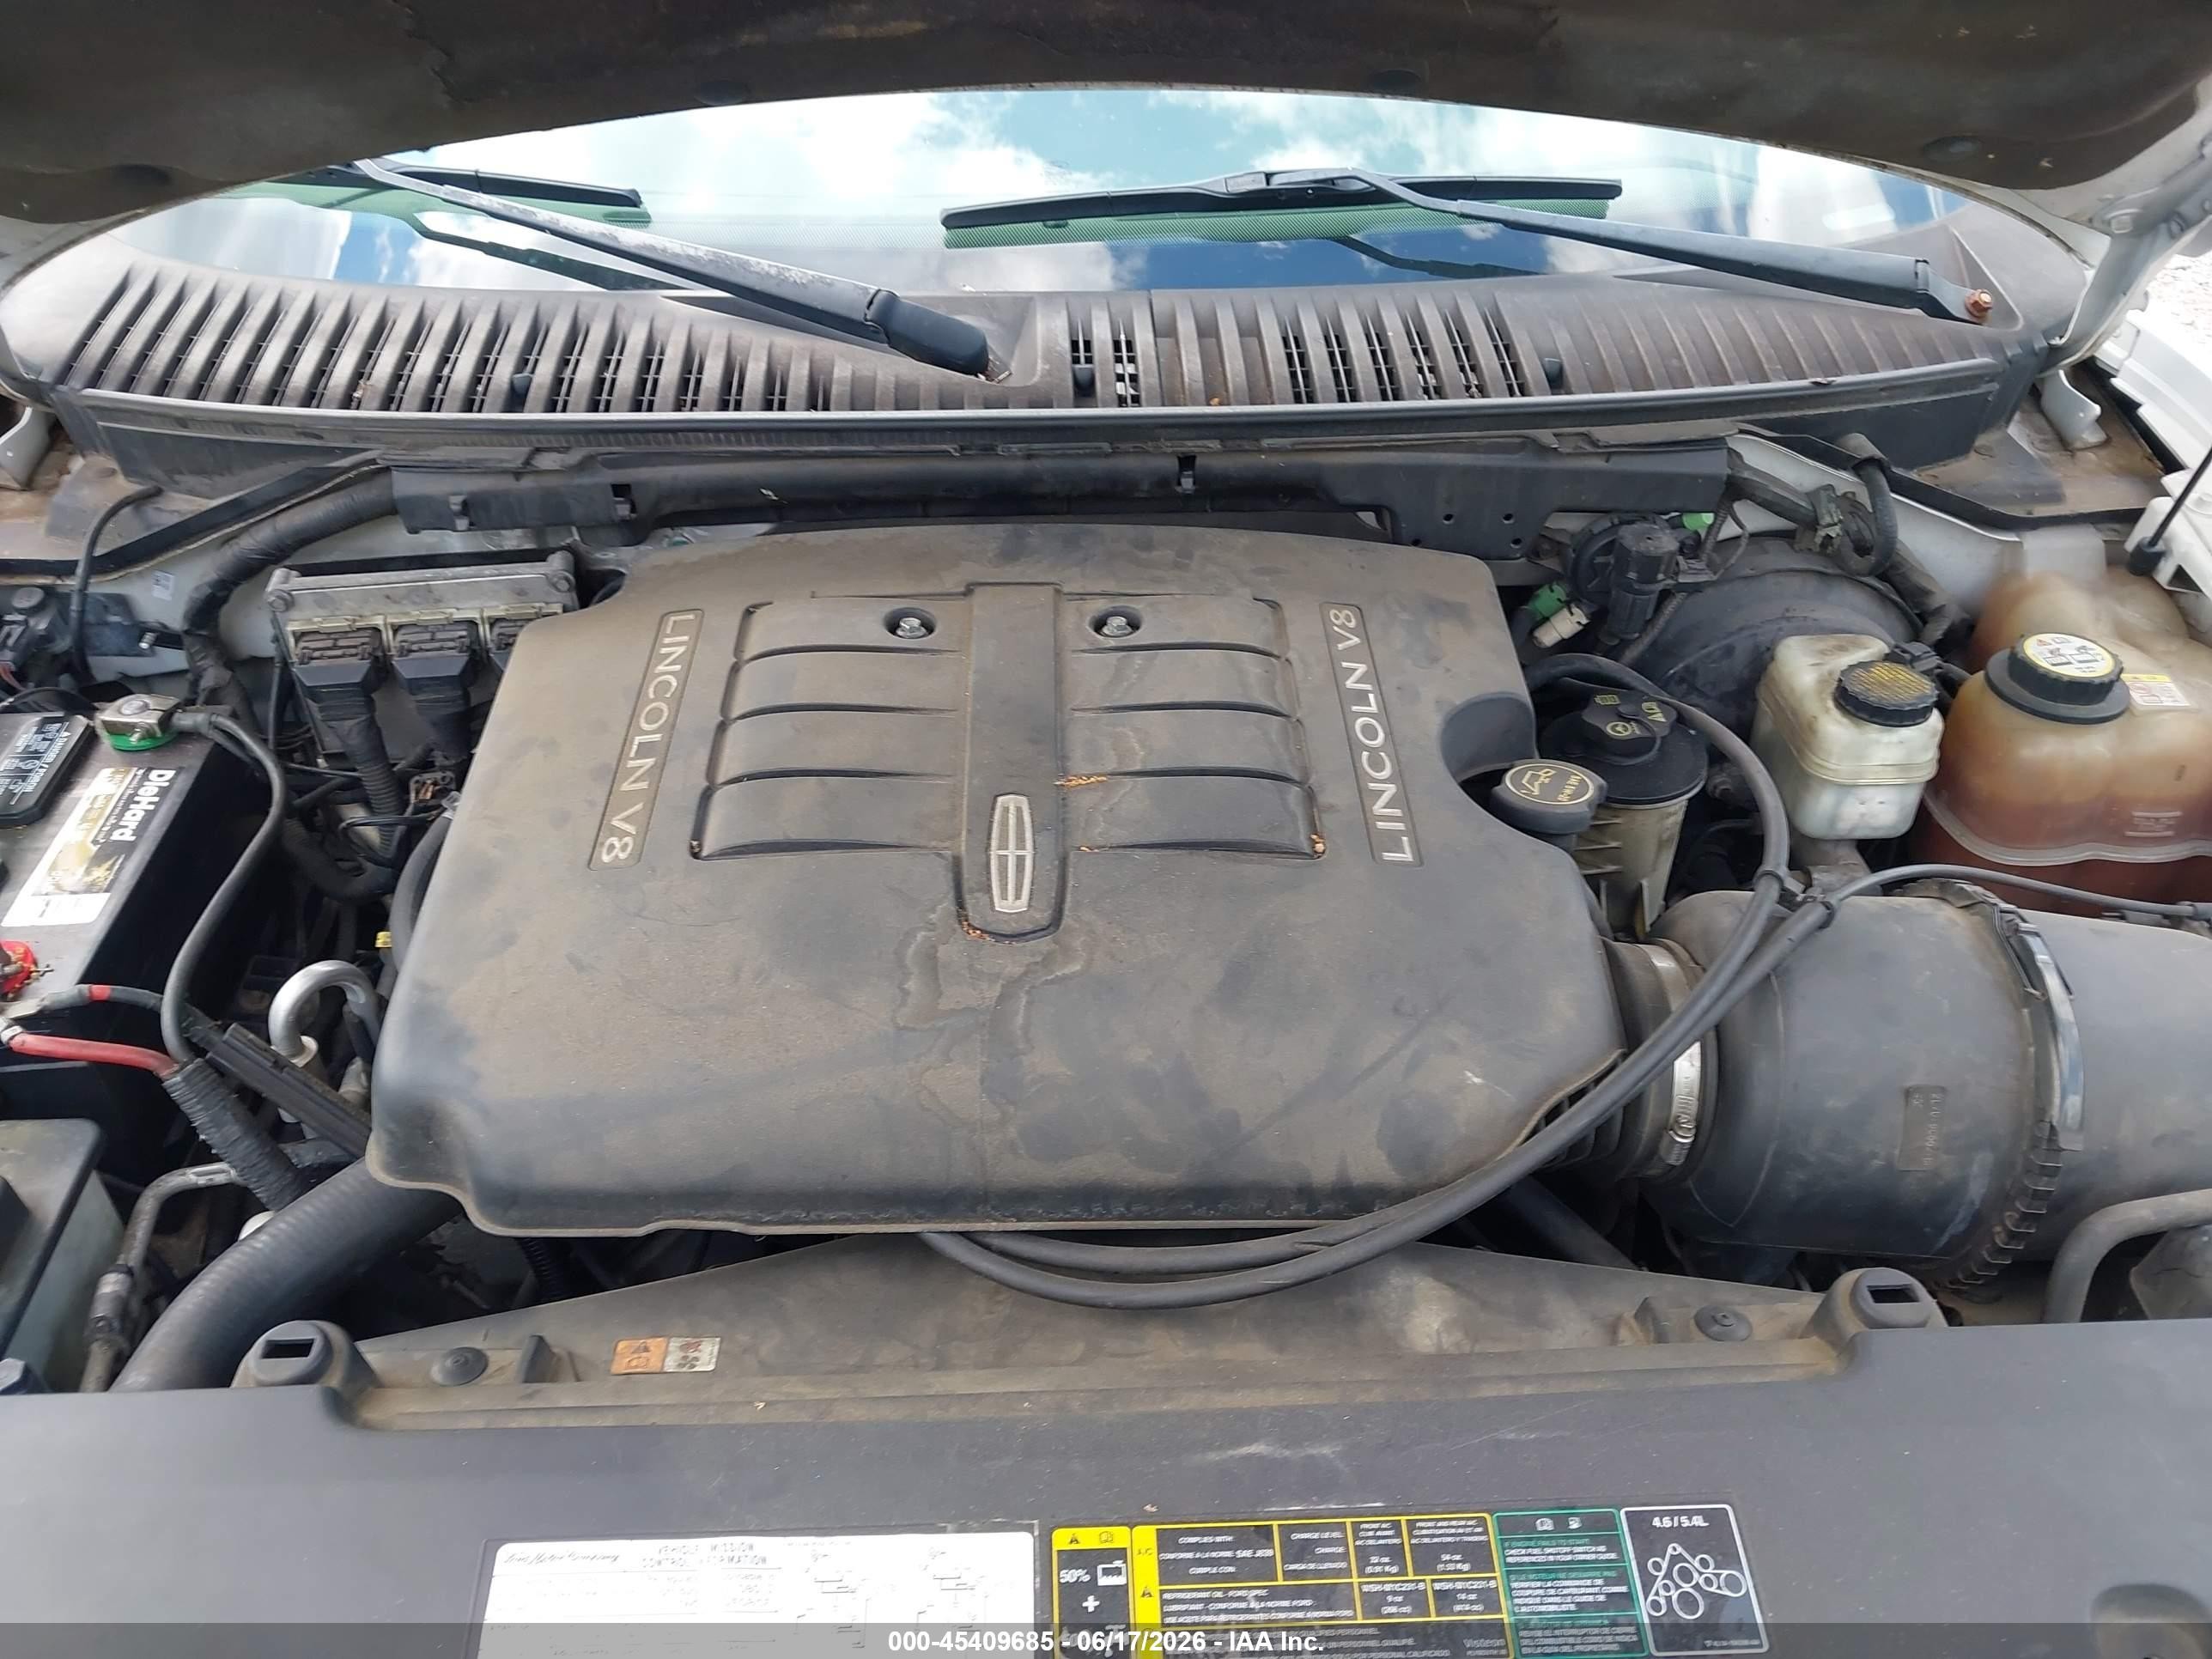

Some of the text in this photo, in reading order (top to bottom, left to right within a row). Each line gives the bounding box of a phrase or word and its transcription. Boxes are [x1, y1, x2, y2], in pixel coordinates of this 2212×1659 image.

[601, 614, 695, 863] LINCOLN V8
[1329, 609, 1415, 861] LINCOLN V8
[1059, 1569, 1091, 1583] 50%
